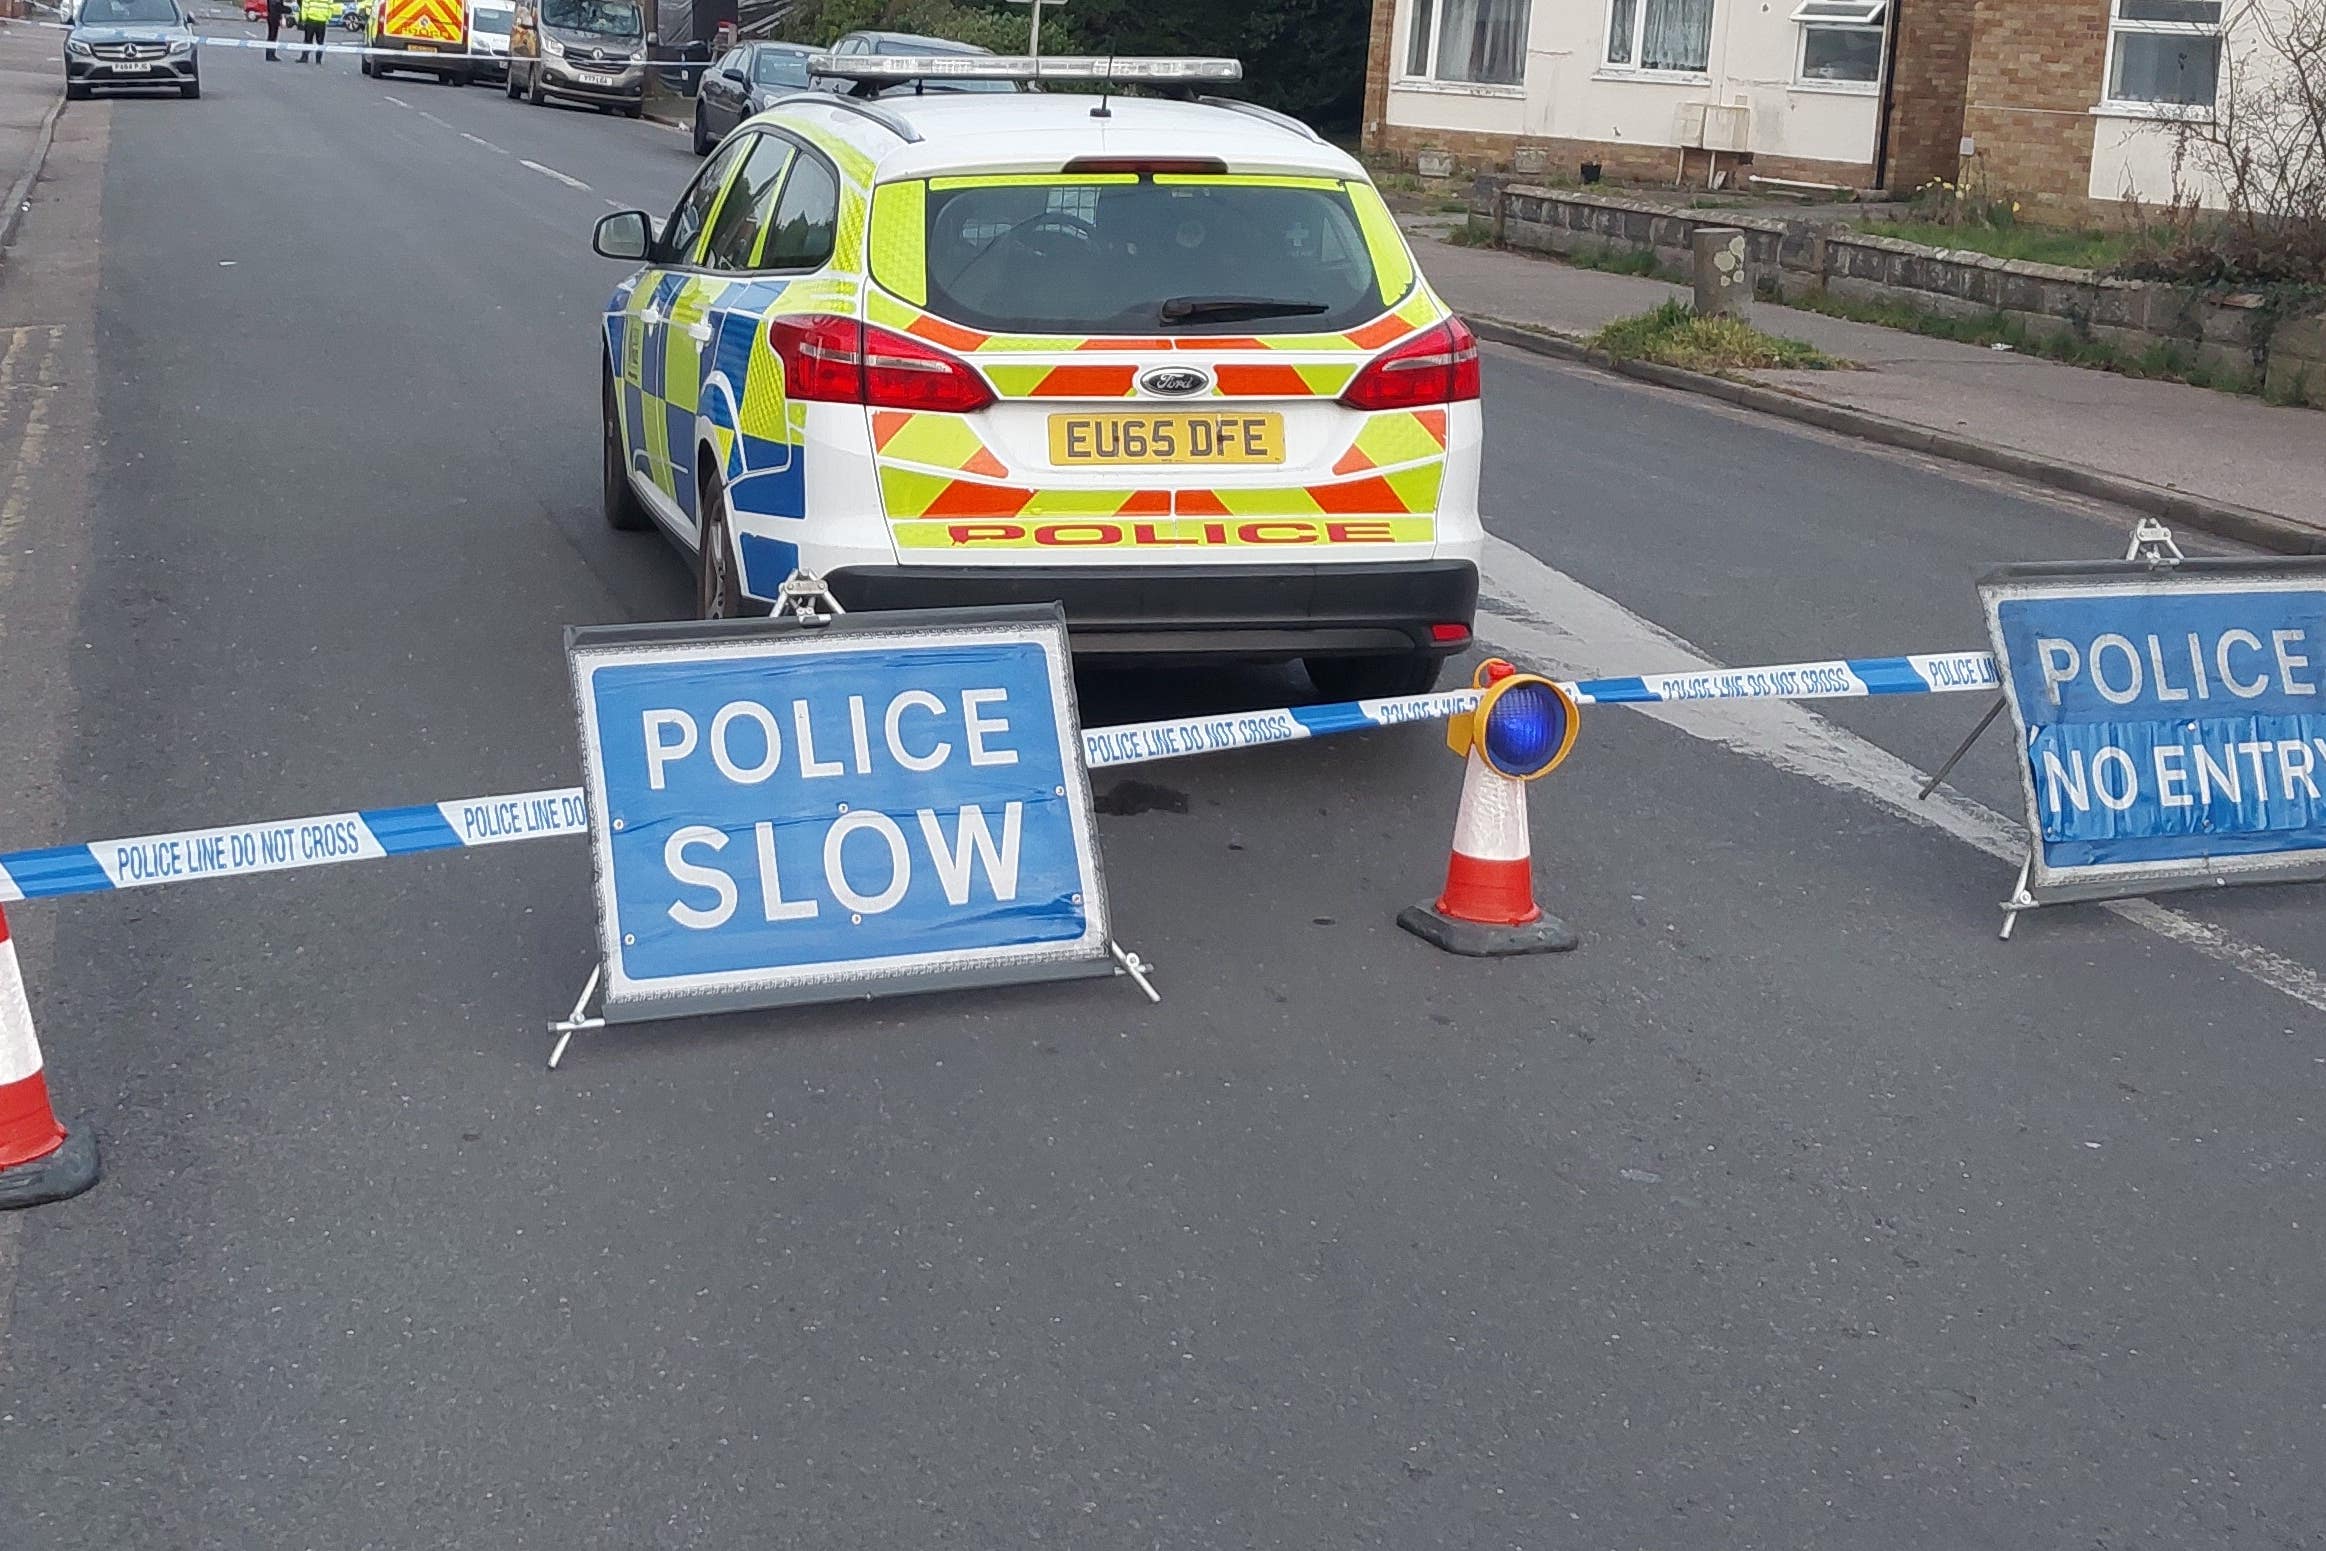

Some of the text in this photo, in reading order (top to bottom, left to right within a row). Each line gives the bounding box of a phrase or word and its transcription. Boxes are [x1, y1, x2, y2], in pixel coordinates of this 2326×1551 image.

[1156, 373, 1193, 389] Ford
[1067, 419, 1268, 457] EU65 DFE
[947, 522, 1395, 546] POLICE
[1749, 672, 1771, 696] DO
[1770, 671, 1800, 695] NOT
[1800, 668, 1850, 693] CROSS
[1929, 658, 1978, 687] POLICE
[2037, 629, 2316, 705] POLICE
[642, 688, 1020, 790] POLICE
[1087, 715, 1292, 764] POLICE LINE DO NOT CROSS
[2043, 746, 2138, 813] NO
[464, 795, 586, 839] POLICE LINE DO
[117, 820, 359, 881] POLICE LINE DO NOT CROSS
[664, 801, 1024, 930] SLOW
